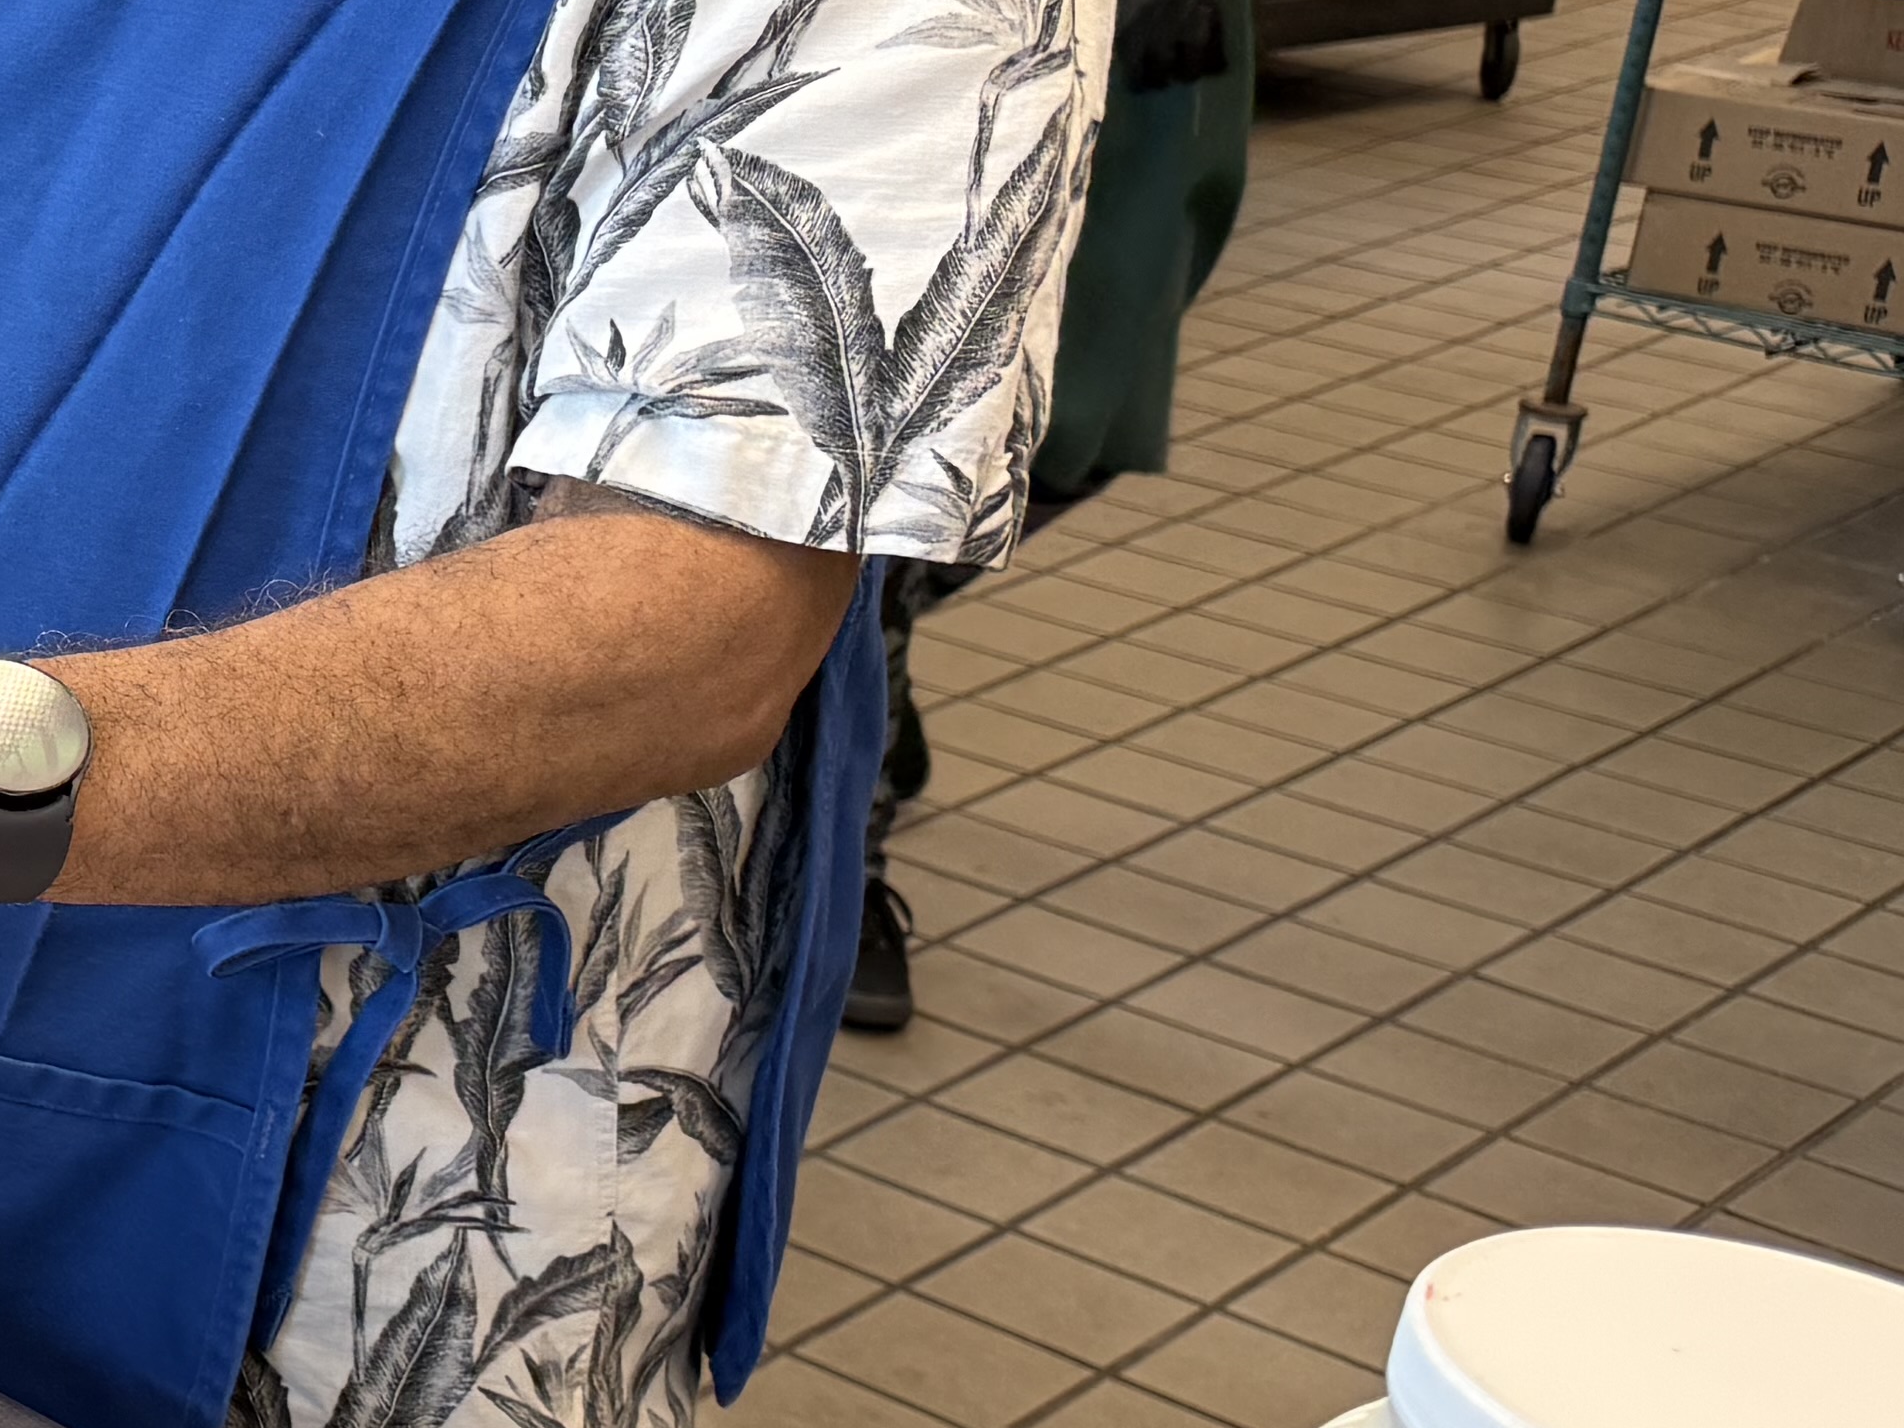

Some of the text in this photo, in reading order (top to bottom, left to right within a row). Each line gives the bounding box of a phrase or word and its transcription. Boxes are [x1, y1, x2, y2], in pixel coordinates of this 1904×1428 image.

[1689, 163, 1713, 184] UP
[1856, 186, 1882, 208] UP
[1697, 276, 1721, 297] UP
[1863, 302, 1889, 326] UP
